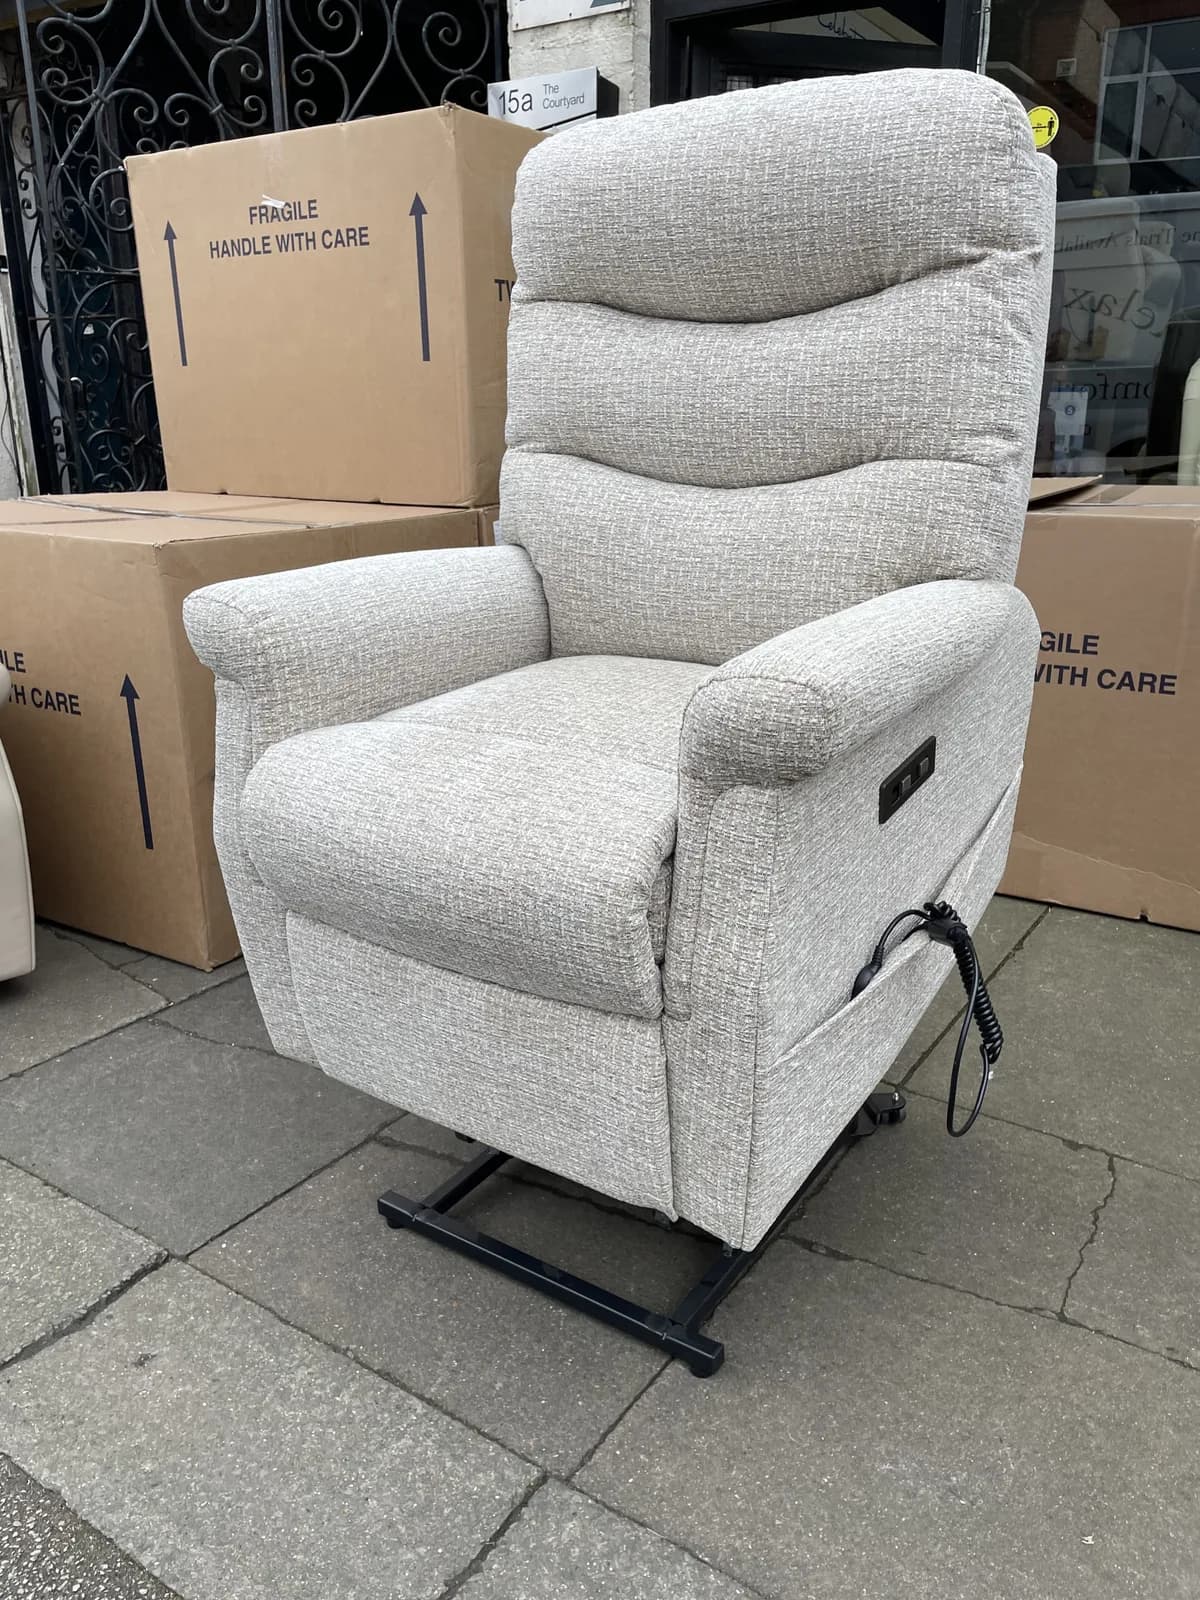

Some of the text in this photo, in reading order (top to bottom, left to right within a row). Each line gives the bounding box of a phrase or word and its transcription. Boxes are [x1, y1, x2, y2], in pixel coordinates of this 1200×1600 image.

[499, 89, 533, 115] 15a
[542, 83, 560, 95] The
[542, 93, 585, 110] Courtyard
[249, 199, 319, 225] FRAGILE
[209, 226, 370, 259] HANDLE WITH CARE
[1097, 668, 1178, 696] CARE
[31, 687, 82, 716] CARE
